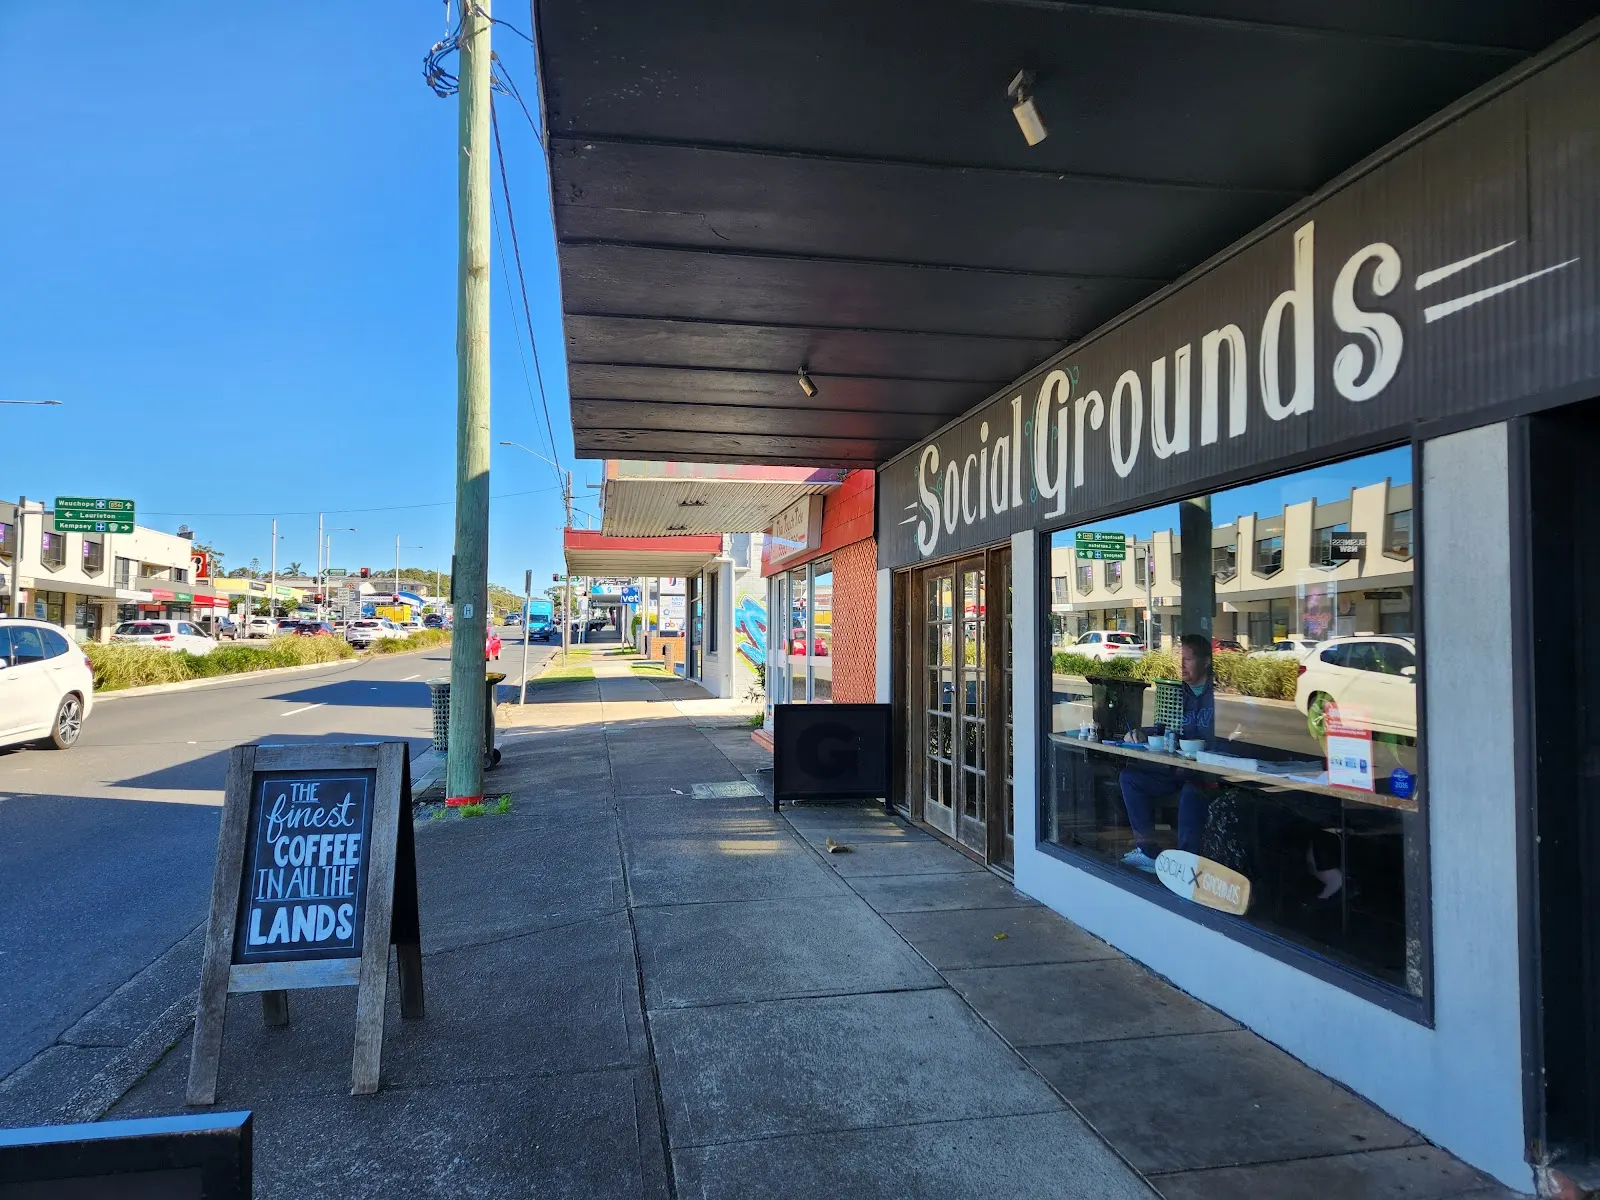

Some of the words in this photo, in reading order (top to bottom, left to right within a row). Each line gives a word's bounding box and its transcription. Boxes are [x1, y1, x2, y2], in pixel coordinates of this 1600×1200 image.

[916, 395, 1023, 557] Social
[1033, 220, 1404, 519] Grounds
[58, 500, 95, 508] Wauchope
[59, 522, 92, 530] Kempsey
[290, 782, 321, 802] THE
[266, 792, 357, 844] finest
[274, 833, 361, 867] COFFEE
[255, 868, 284, 899] IN
[285, 866, 320, 898] ALL
[322, 865, 356, 897] THE
[249, 903, 354, 946] LANDS
